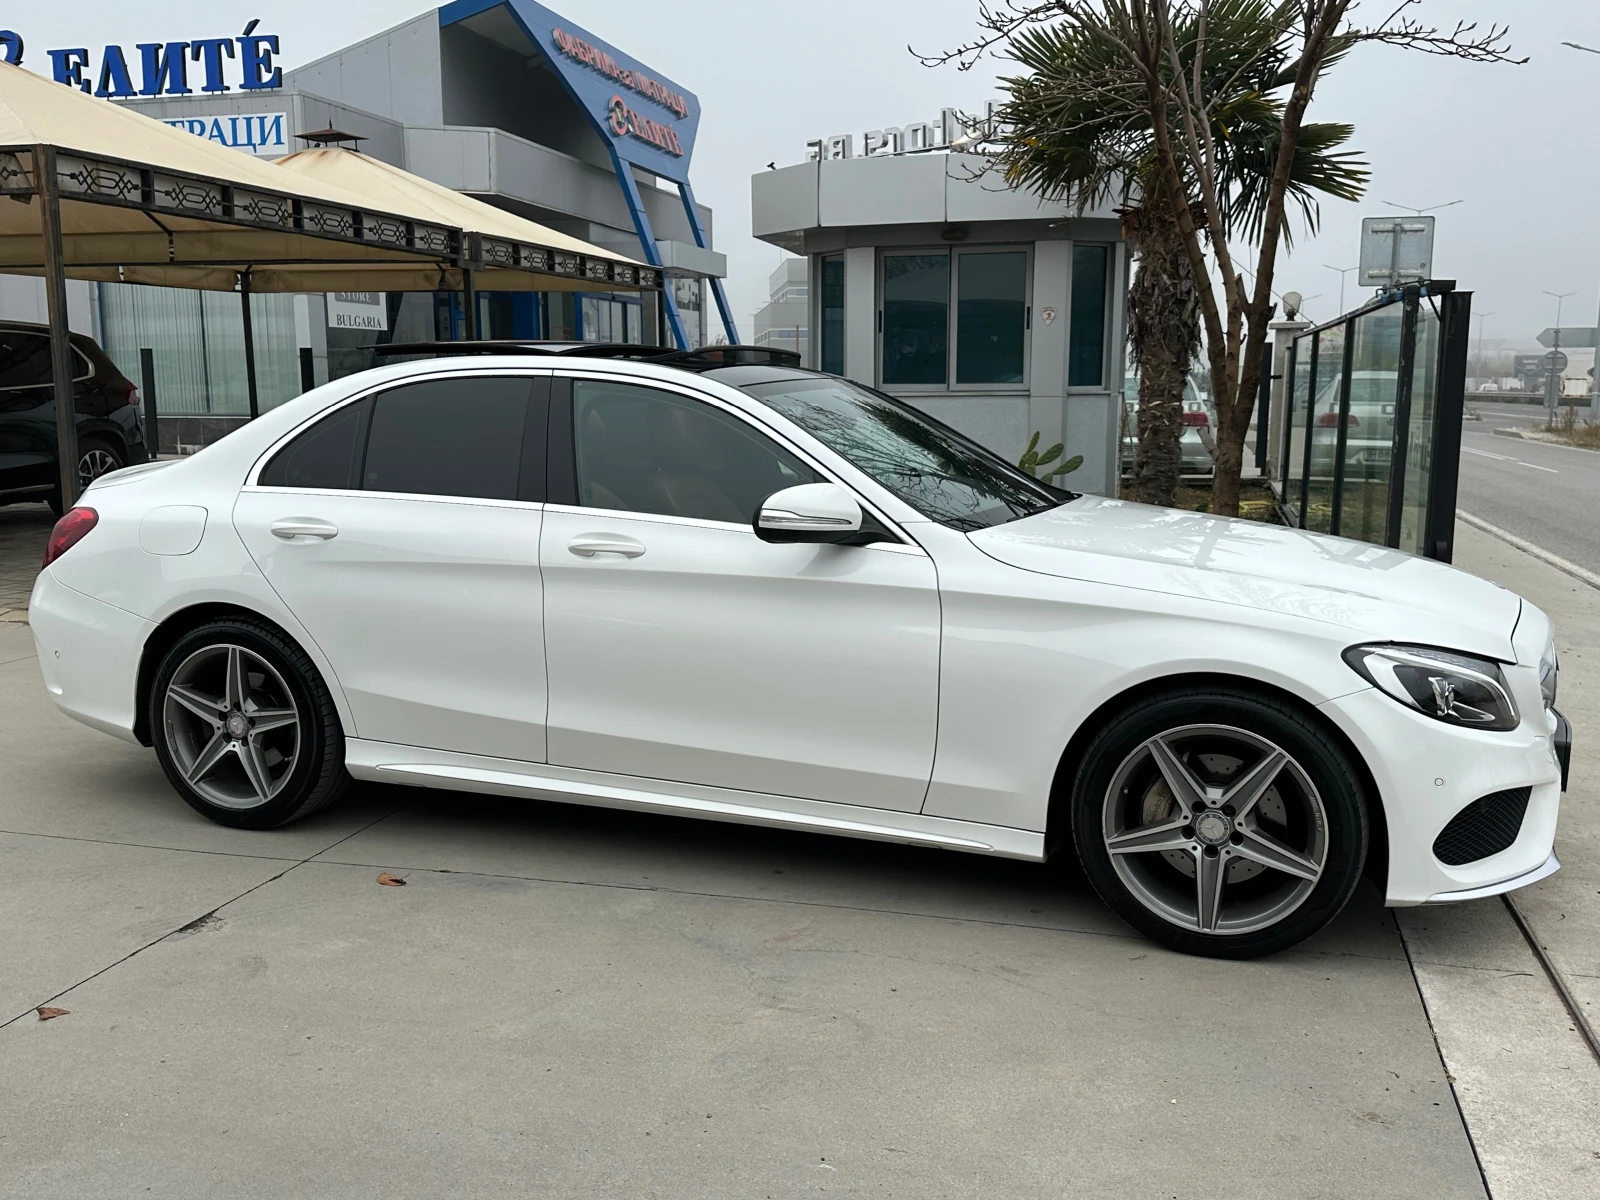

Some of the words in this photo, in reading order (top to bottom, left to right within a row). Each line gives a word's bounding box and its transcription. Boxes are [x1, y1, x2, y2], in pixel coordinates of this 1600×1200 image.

[552, 27, 620, 78] ФАБРИКА
[632, 70, 689, 119] МАТРАЦИ
[336, 313, 382, 329] BULGARIA
